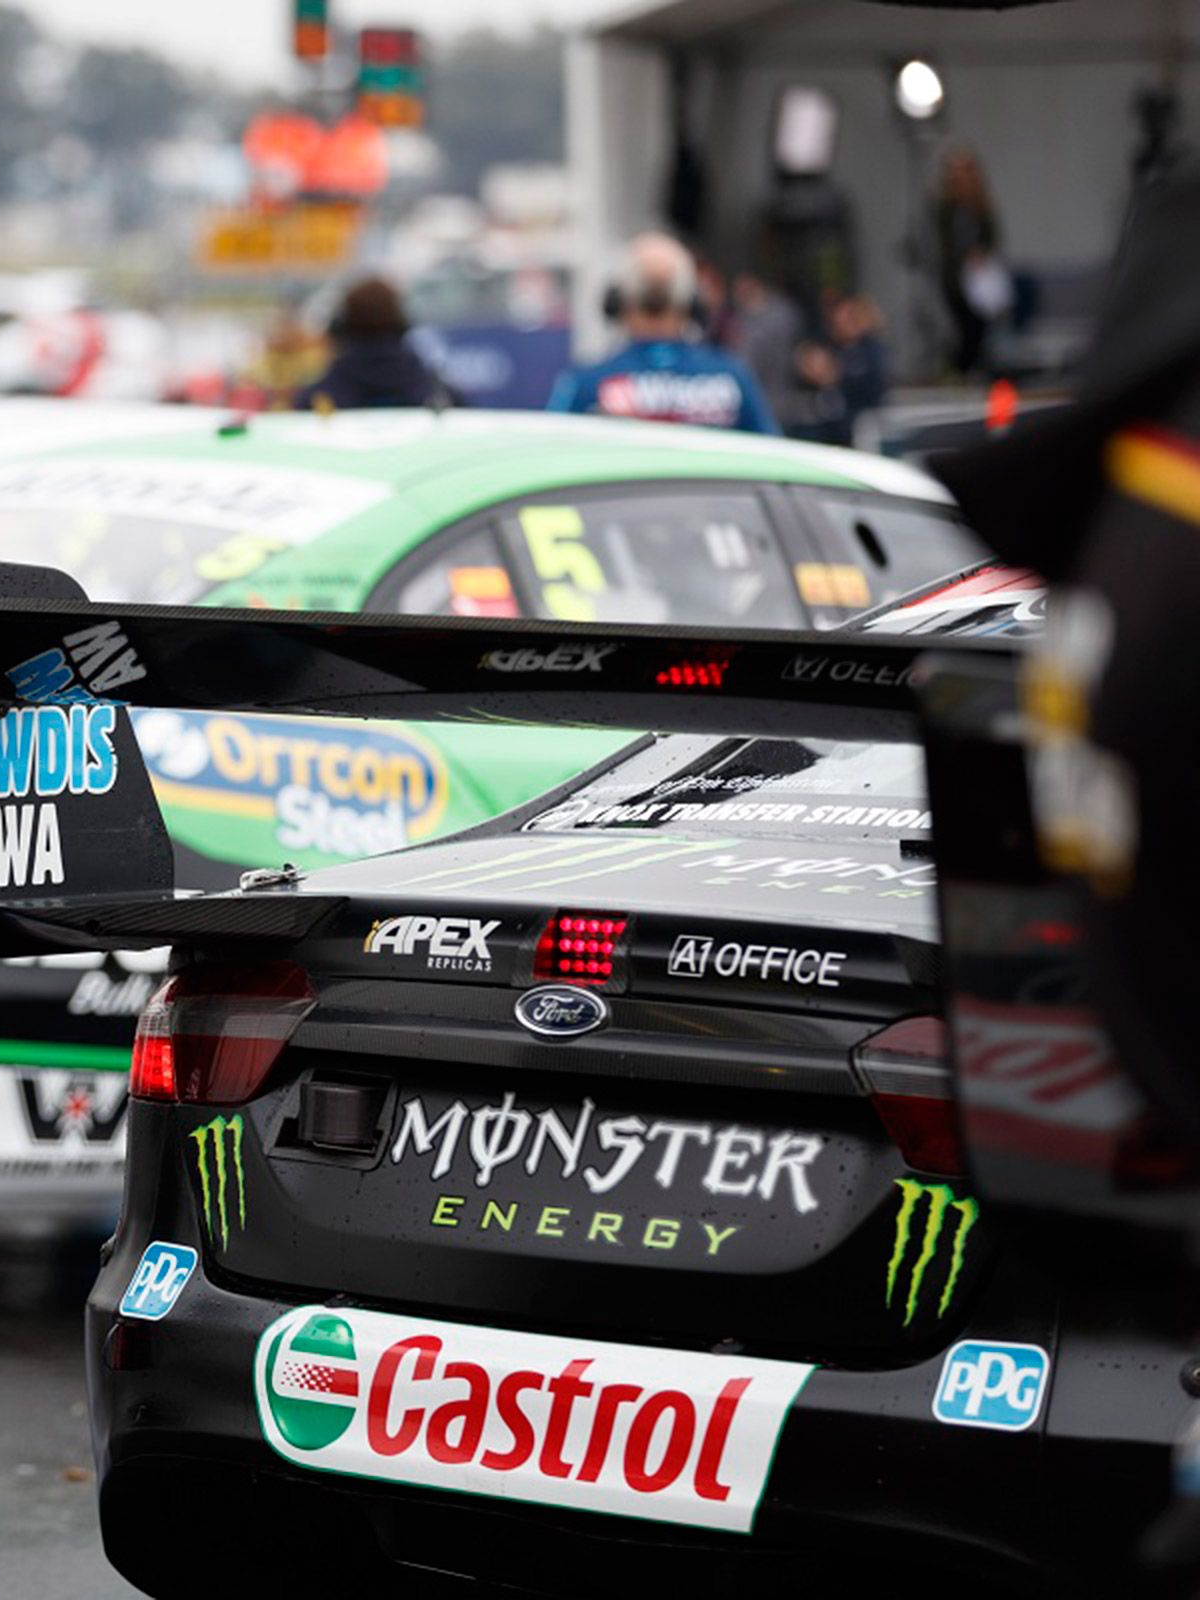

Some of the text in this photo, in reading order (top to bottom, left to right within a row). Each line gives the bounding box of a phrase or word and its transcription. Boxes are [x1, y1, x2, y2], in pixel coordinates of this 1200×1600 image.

[518, 505, 608, 621] 5
[204, 718, 425, 809] Orrcon
[276, 784, 406, 855] Steel
[579, 802, 663, 824] KNOX
[668, 803, 807, 824] TRANSFER
[370, 915, 501, 960] APEX
[426, 956, 493, 973] REPLICAS
[671, 938, 848, 987] A1 OFFICE
[532, 995, 586, 1024] Ford
[431, 1196, 738, 1256] ENERGY
[127, 1251, 190, 1309] PPG
[942, 1350, 1041, 1416] PPG
[366, 1333, 755, 1502] Castrol
